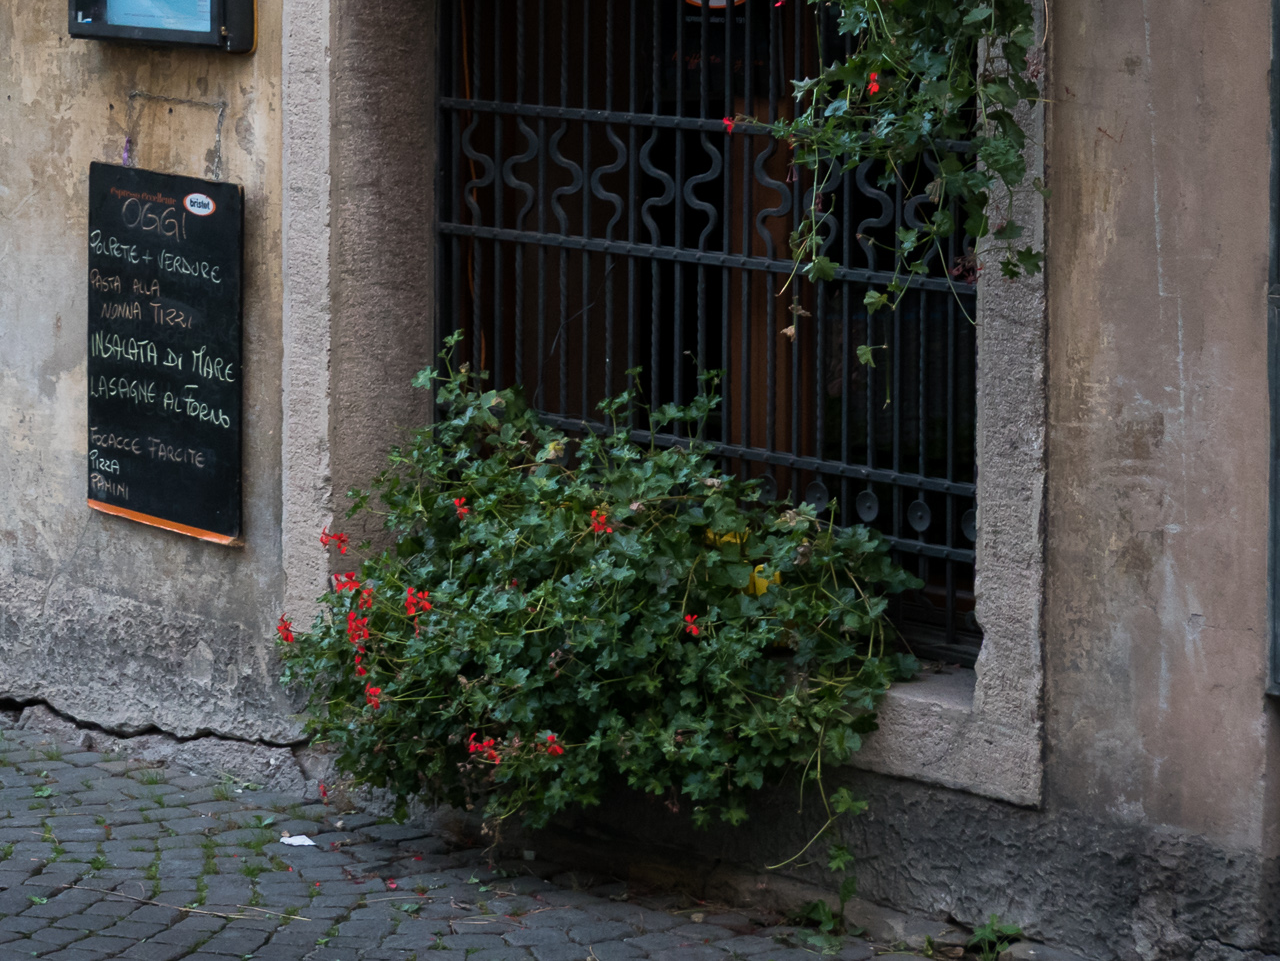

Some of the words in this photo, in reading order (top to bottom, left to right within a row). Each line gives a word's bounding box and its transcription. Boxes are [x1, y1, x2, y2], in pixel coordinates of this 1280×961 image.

[122, 197, 187, 242] OGGI
[90, 268, 121, 293] PASTA
[133, 278, 160, 297] ALLA
[142, 250, 153, 264] +
[157, 249, 221, 283] VERDURE
[101, 301, 141, 320] NONNA
[91, 330, 157, 366] INSALATA
[192, 345, 235, 382] MARE
[90, 375, 156, 404] LASAGNE
[163, 391, 182, 412] AL
[183, 384, 230, 428] FORNO
[89, 449, 120, 475] PIZZA
[90, 426, 142, 454] FOCACCE
[147, 436, 205, 468] FARCITE
[90, 473, 129, 500] PANINI
